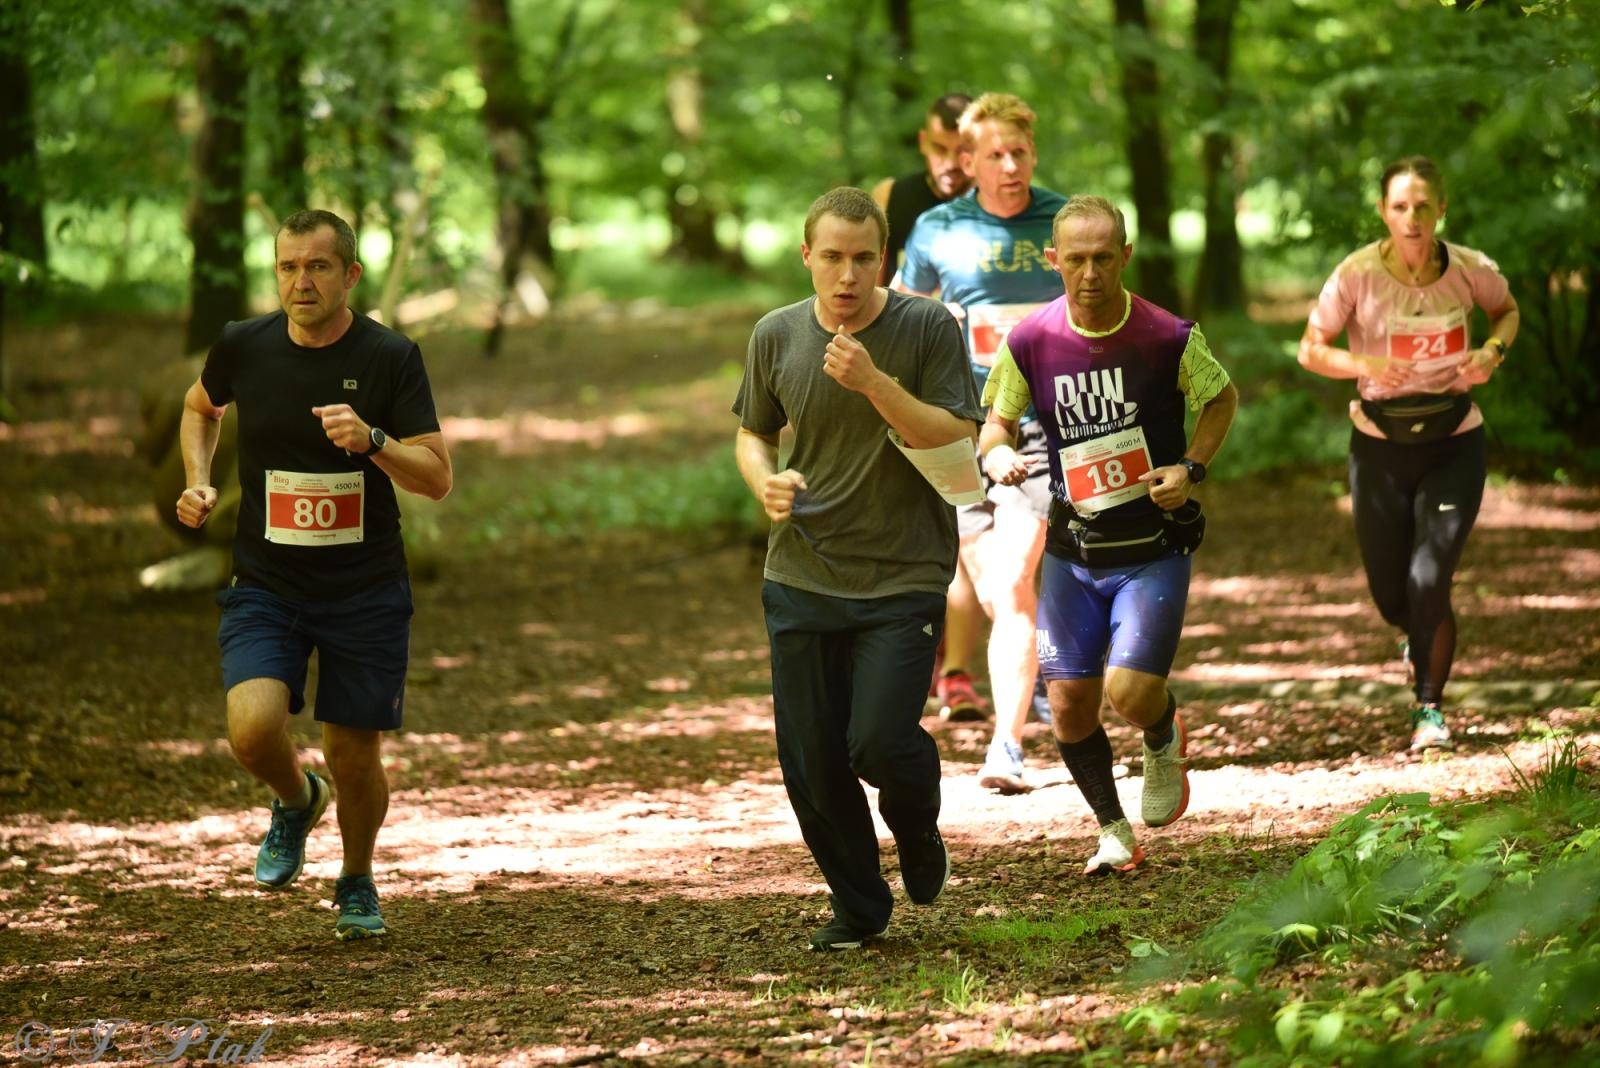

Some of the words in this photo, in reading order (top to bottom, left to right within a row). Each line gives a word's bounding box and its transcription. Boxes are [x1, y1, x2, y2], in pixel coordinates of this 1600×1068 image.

[1411, 334, 1448, 360] 24
[1053, 366, 1126, 427] RUN
[1115, 440, 1133, 449] 4500
[1133, 437, 1141, 445] M
[334, 482, 353, 490] 4500
[1086, 459, 1127, 494] 18
[293, 497, 337, 528] 80
